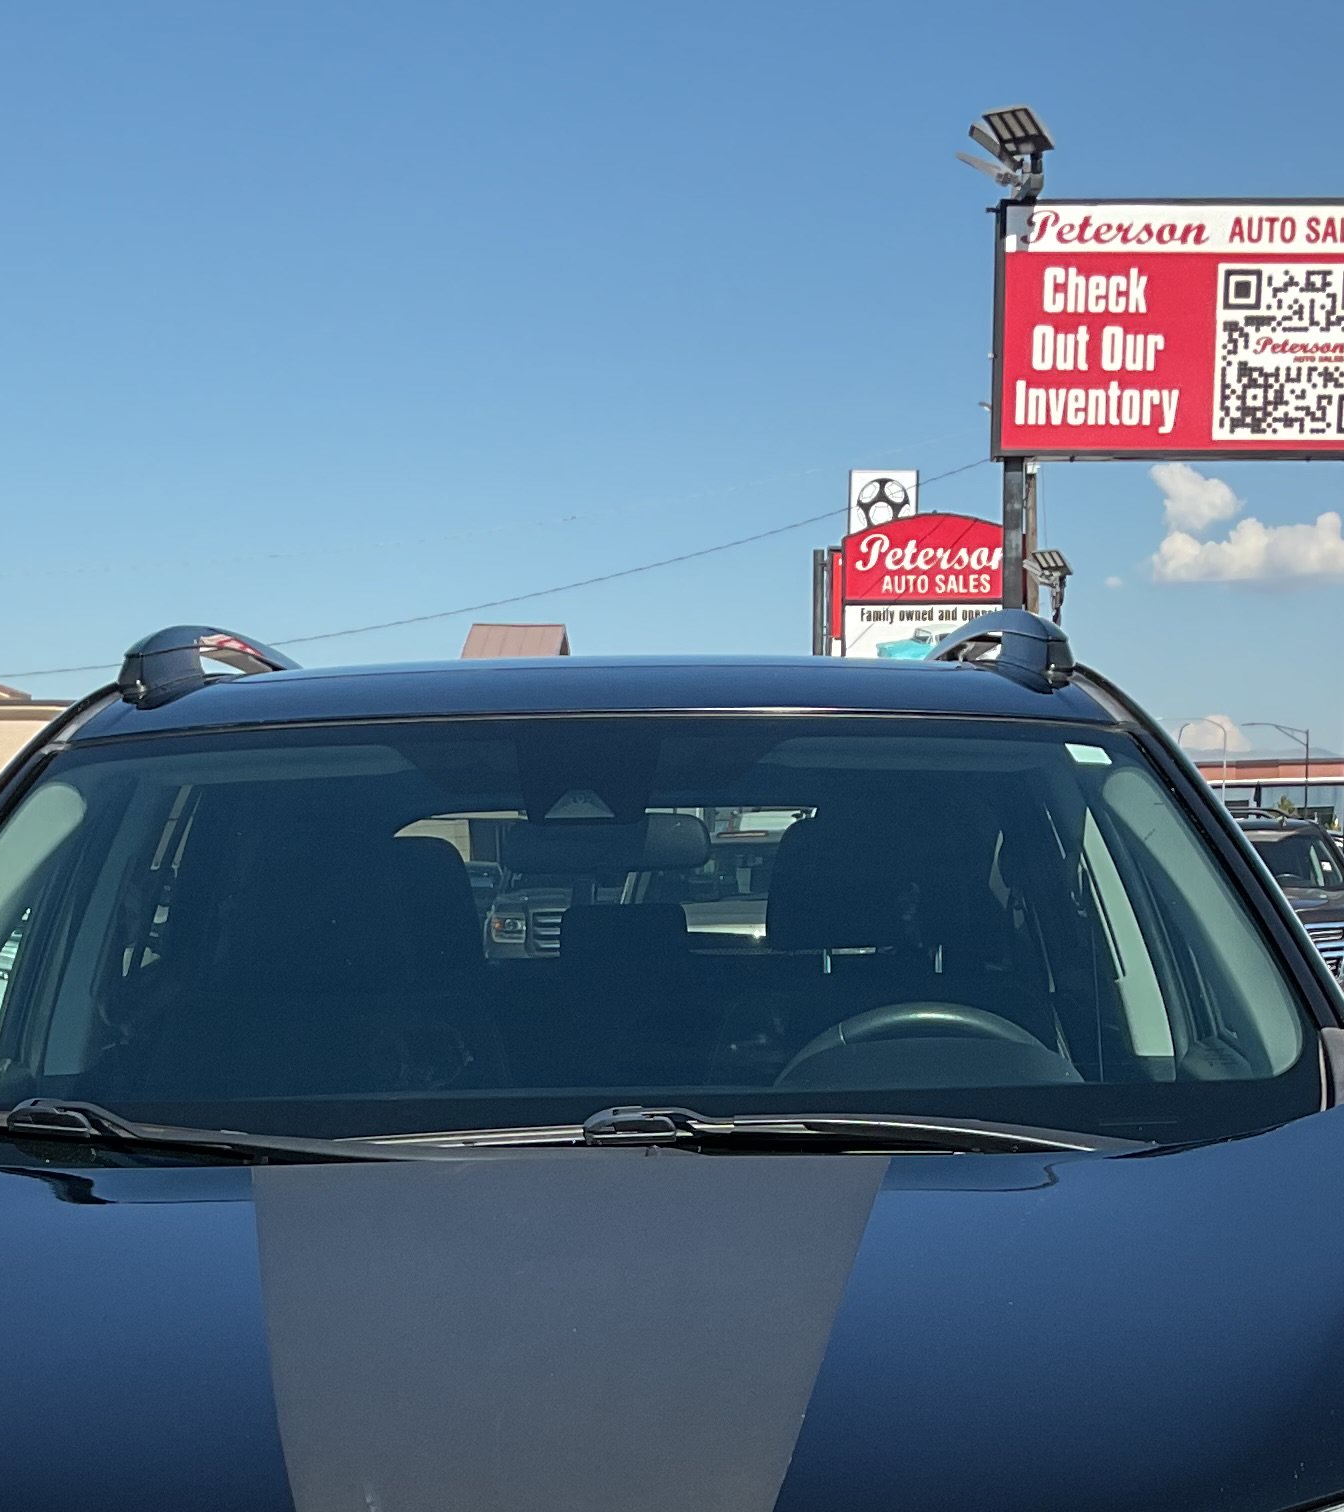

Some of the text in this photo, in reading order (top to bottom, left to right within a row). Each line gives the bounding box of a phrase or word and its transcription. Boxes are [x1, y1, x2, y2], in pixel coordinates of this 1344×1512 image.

[1020, 210, 1210, 245] Peterson
[1228, 216, 1296, 243] AUTO
[1043, 266, 1148, 314] Check
[1032, 324, 1164, 372] Out Our
[1014, 380, 1180, 434] Inventory
[881, 574, 991, 594] AUTO SALES
[860, 607, 894, 624] Family
[899, 607, 934, 621] owned
[938, 607, 957, 621] and
